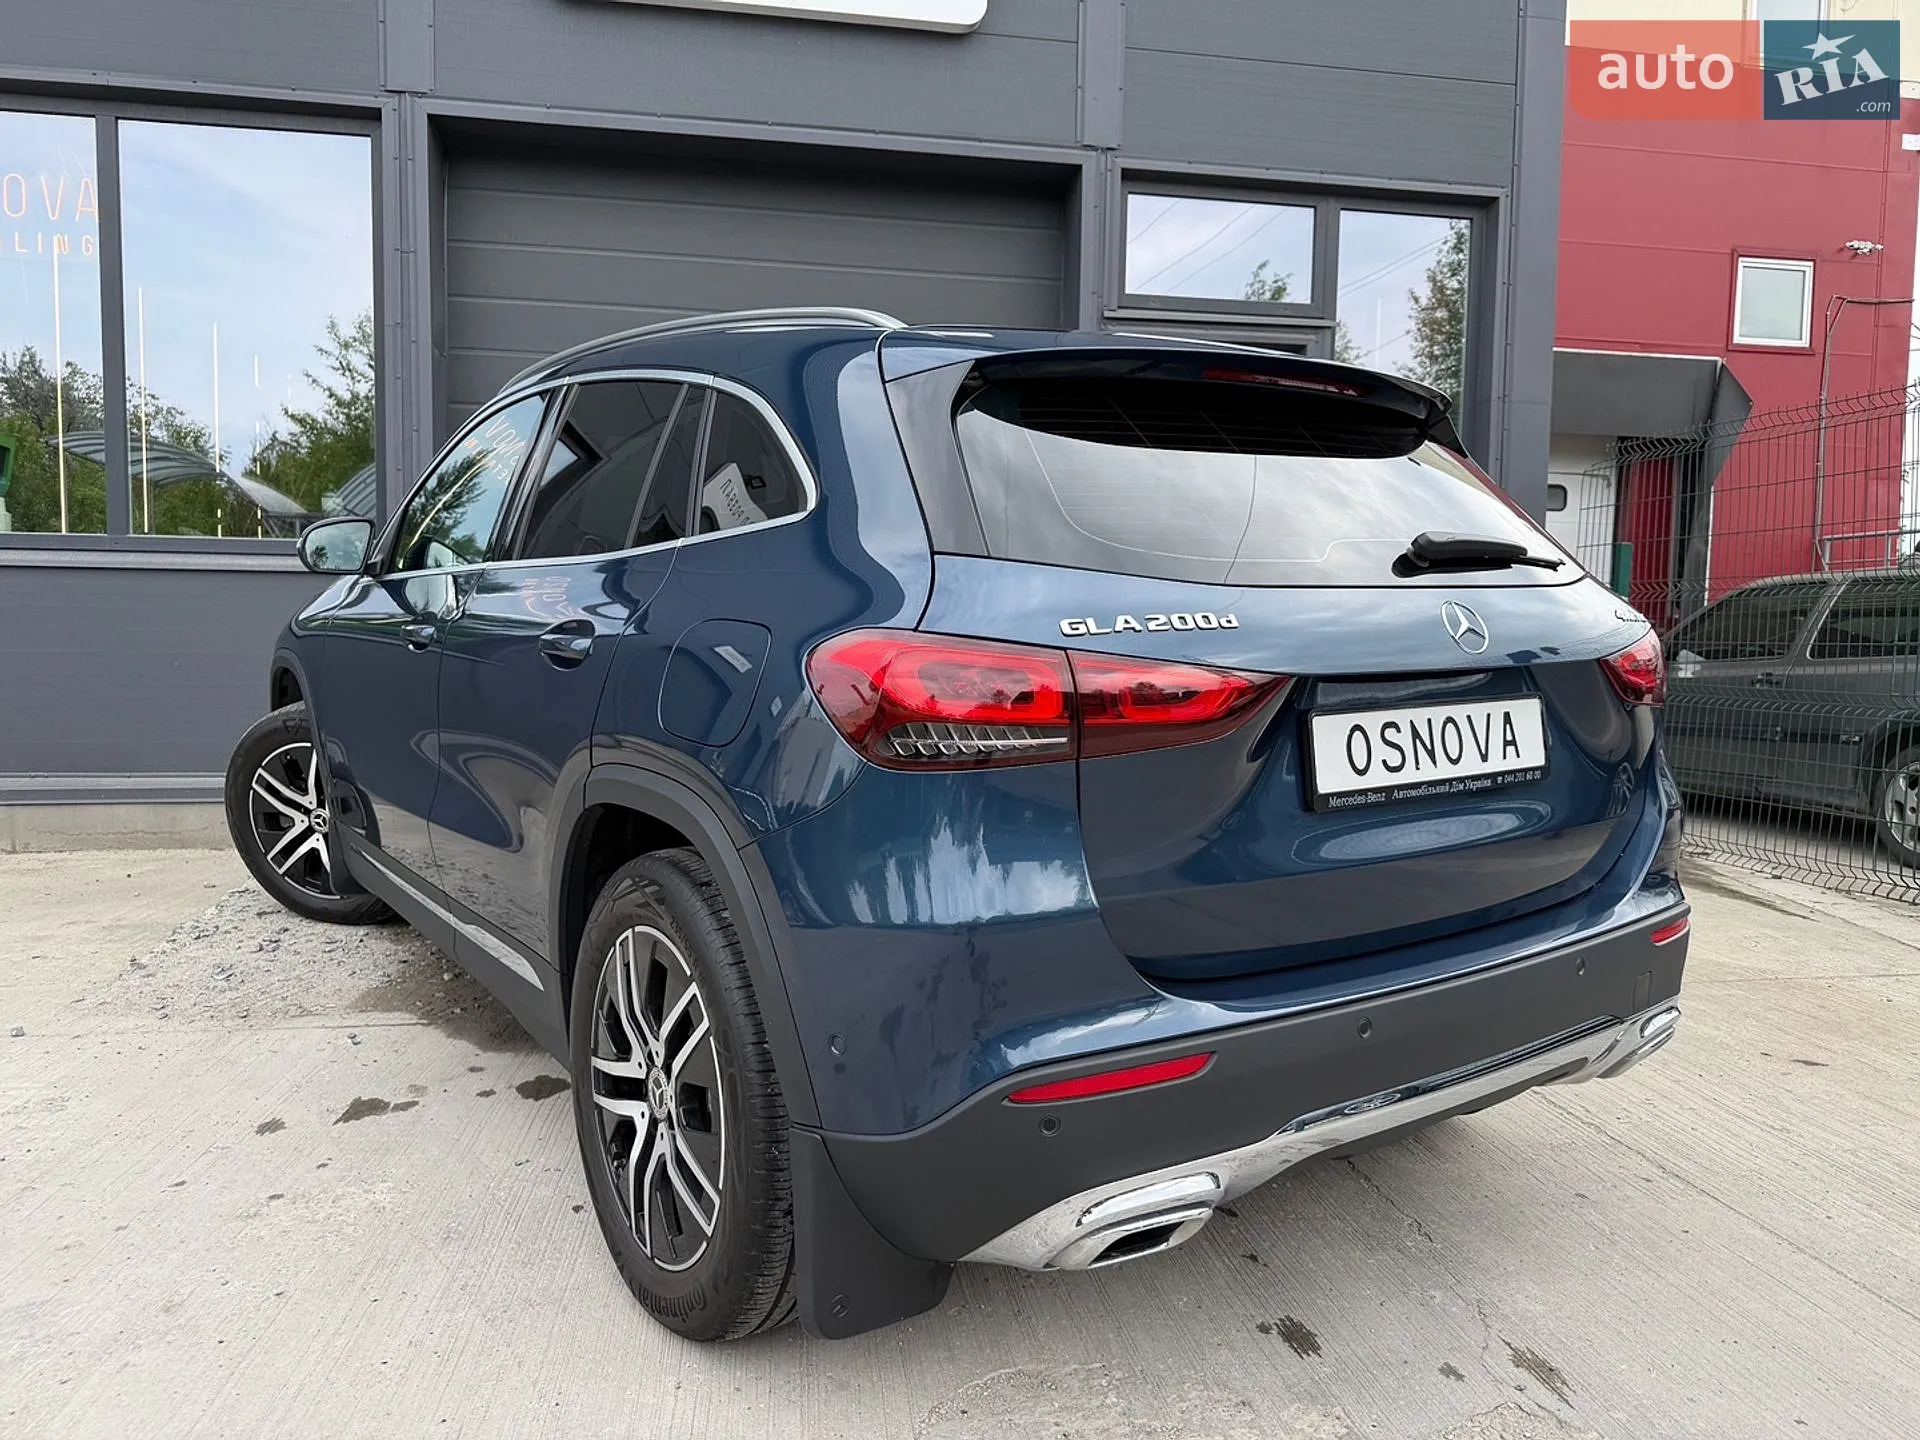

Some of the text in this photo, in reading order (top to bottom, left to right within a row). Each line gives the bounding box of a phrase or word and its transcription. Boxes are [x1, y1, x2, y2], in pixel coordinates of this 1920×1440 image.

[1346, 711, 1520, 776] OSNOVA
[1328, 792, 1386, 808] Mercedes-Benz
[1449, 780, 1464, 793] Дім
[1465, 778, 1492, 792] Україна
[638, 1282, 708, 1324] Continental
